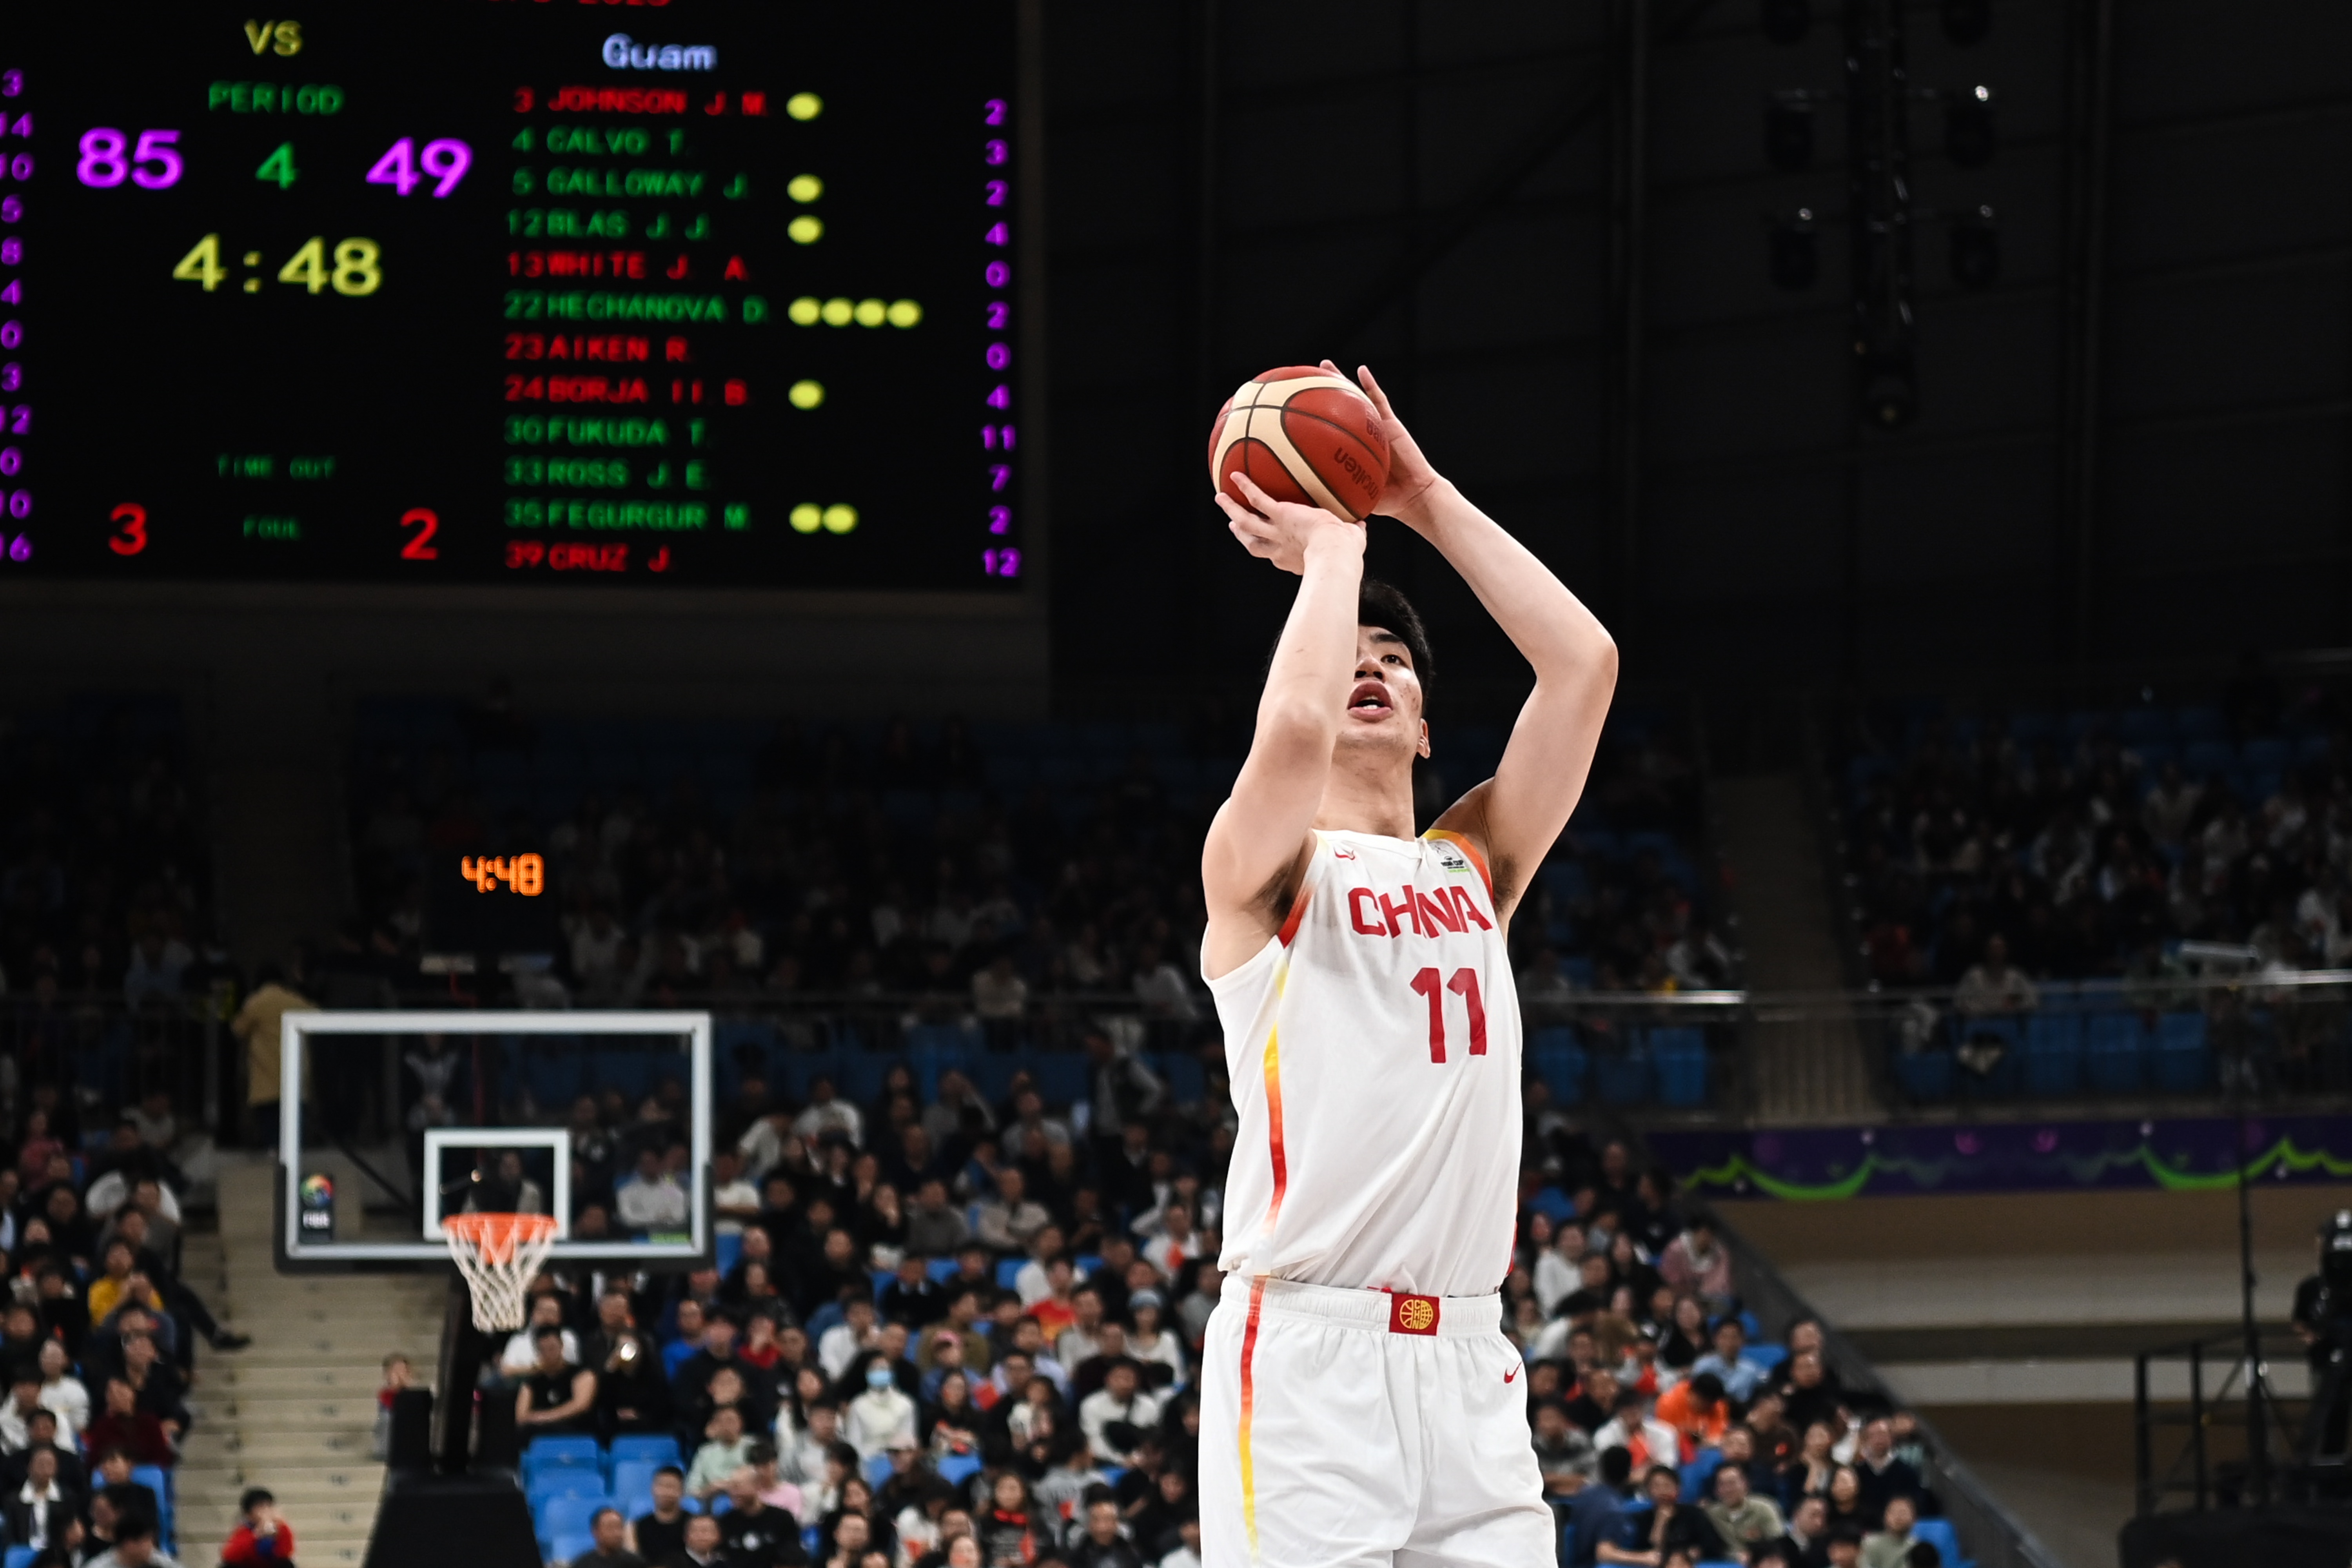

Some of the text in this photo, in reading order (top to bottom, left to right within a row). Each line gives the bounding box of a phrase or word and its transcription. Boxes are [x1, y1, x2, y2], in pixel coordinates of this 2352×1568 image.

[243, 20, 302, 57] VS
[601, 33, 717, 71] Guam
[2, 69, 24, 98] 3
[208, 82, 344, 115] PERIOD
[513, 85, 767, 116] 3 JOHNSON J M
[985, 98, 1007, 126] 2
[512, 127, 535, 153] 4
[666, 128, 685, 156] T
[985, 139, 1008, 166] 3
[76, 127, 185, 191] 85
[255, 142, 297, 189] 4
[365, 136, 474, 200] 49
[512, 167, 748, 200] 5 GALLOWAY J
[985, 180, 1008, 207] 2
[506, 209, 709, 241] 12 BLAS J J
[985, 221, 1009, 246] 4
[0, 237, 23, 266] 8
[172, 233, 382, 297] 4:48
[506, 250, 748, 281] 13 WHITE J A
[985, 260, 1010, 288] 0
[0, 279, 22, 305] 4
[504, 291, 768, 325] 22 HECHANOVA D
[987, 301, 1009, 330] 2
[0, 320, 23, 349] 0
[505, 333, 690, 363] 23 AIKEN R
[985, 342, 1011, 371] 0
[1, 363, 22, 392] 3
[505, 374, 544, 402] 24
[547, 375, 650, 404] BORJA
[724, 378, 749, 407] B
[986, 385, 1010, 410] 4
[504, 415, 706, 448] 30 FUKUDA T
[981, 425, 1016, 450] 11
[0, 447, 22, 476] 0
[546, 457, 631, 488] ROSS
[646, 461, 670, 489] J
[684, 459, 707, 490] E
[990, 465, 1010, 491] 7
[109, 503, 148, 556] 3
[547, 499, 708, 531] FEGURGUR
[723, 503, 750, 532] M
[989, 505, 1011, 535] 2
[400, 507, 439, 561] 2
[505, 541, 671, 573] 39 CRUZ J
[982, 548, 1021, 577] 12
[461, 852, 544, 897] 4:48
[1348, 884, 1493, 939] CHNA
[1410, 967, 1487, 1063] 11
